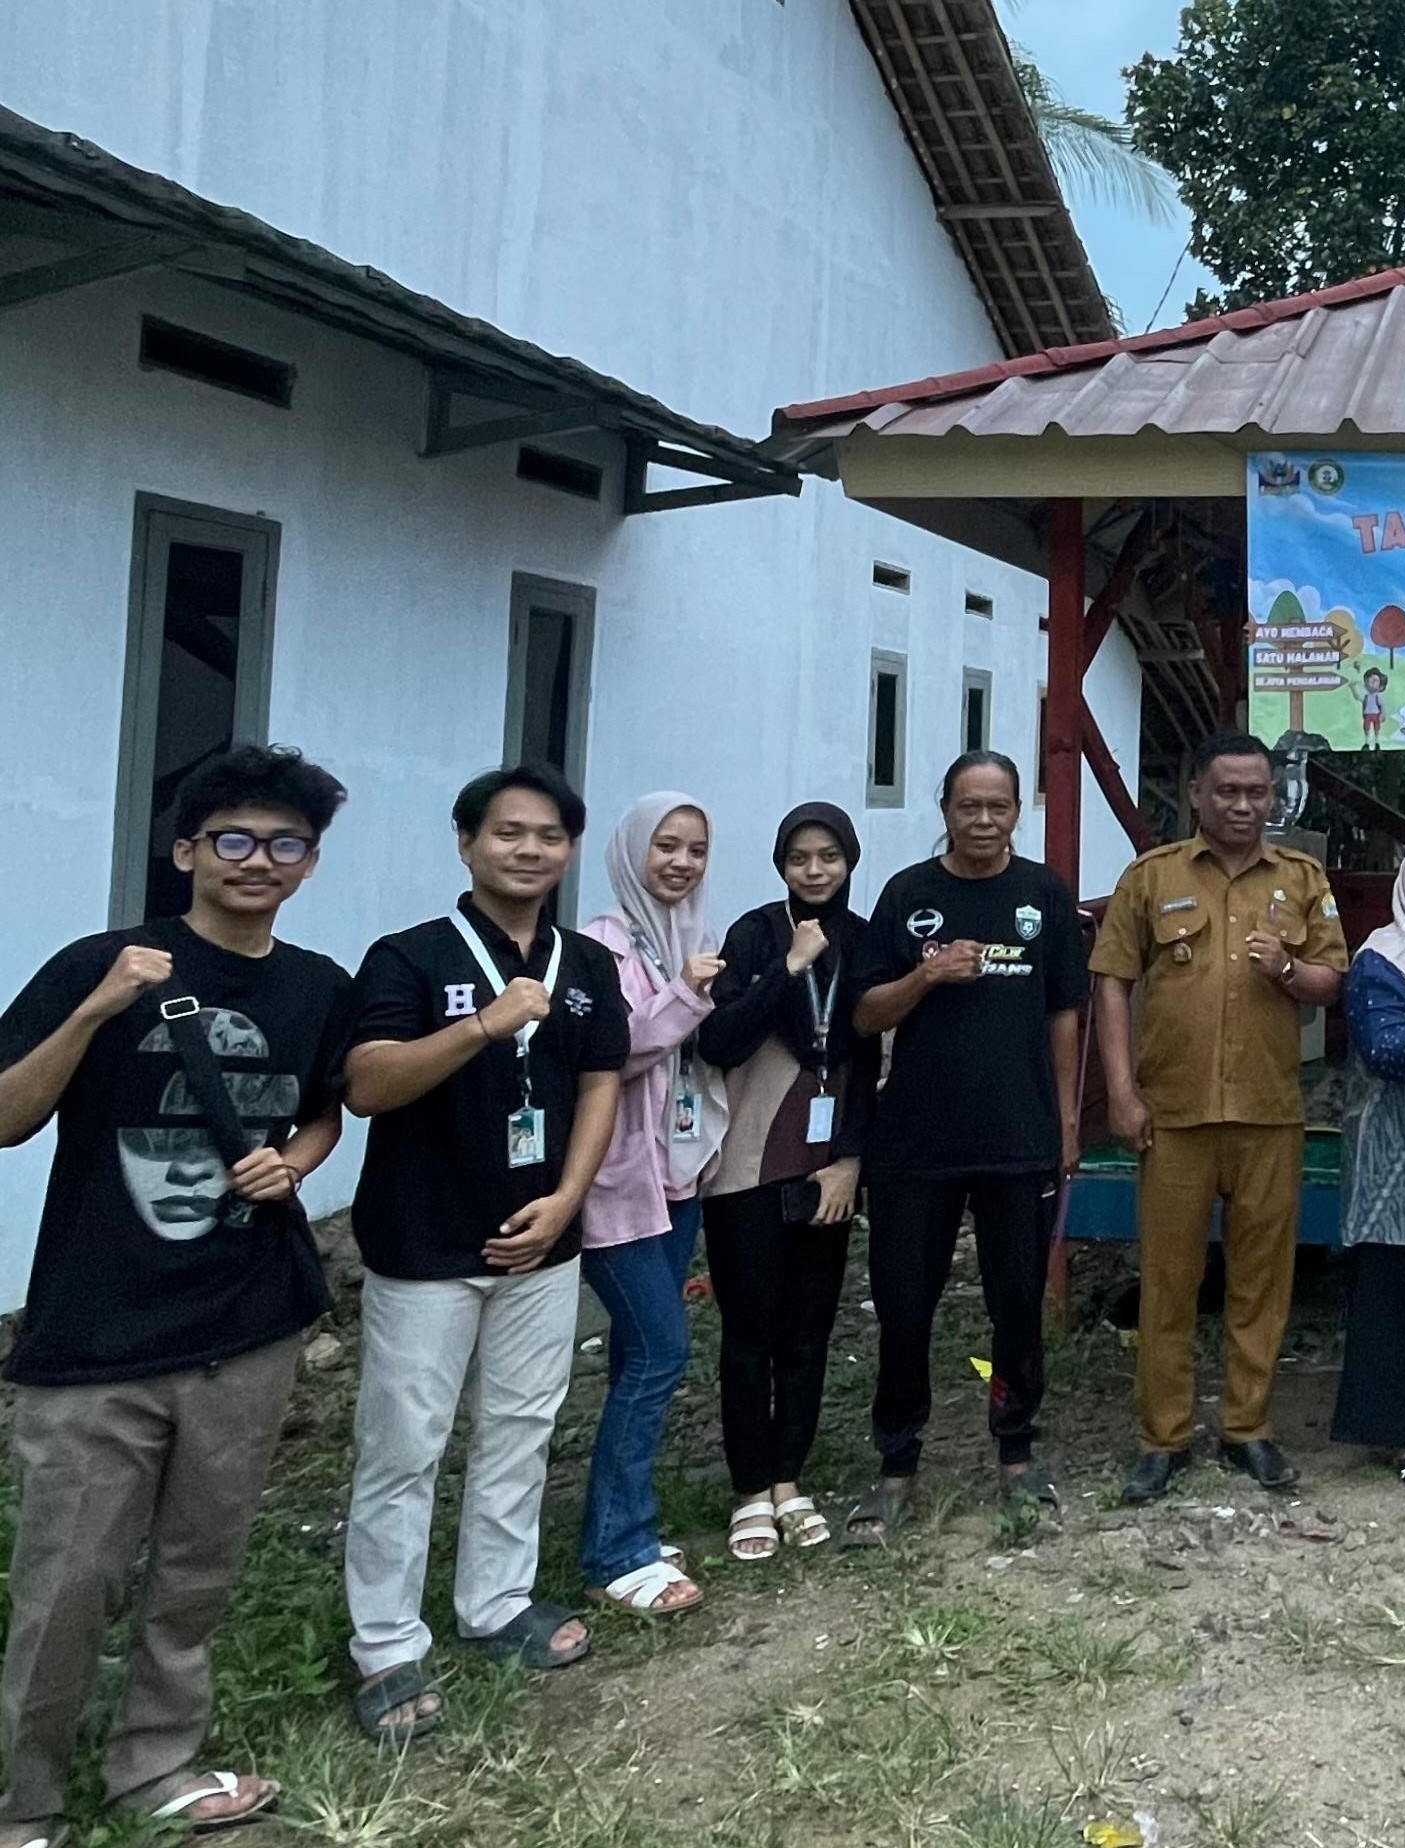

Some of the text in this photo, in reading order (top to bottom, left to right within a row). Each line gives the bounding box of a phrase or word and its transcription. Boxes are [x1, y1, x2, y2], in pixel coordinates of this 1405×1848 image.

[1255, 626, 1279, 638] AYO
[1255, 650, 1340, 664] SATU HALAMAN
[444, 983, 477, 1017] H
